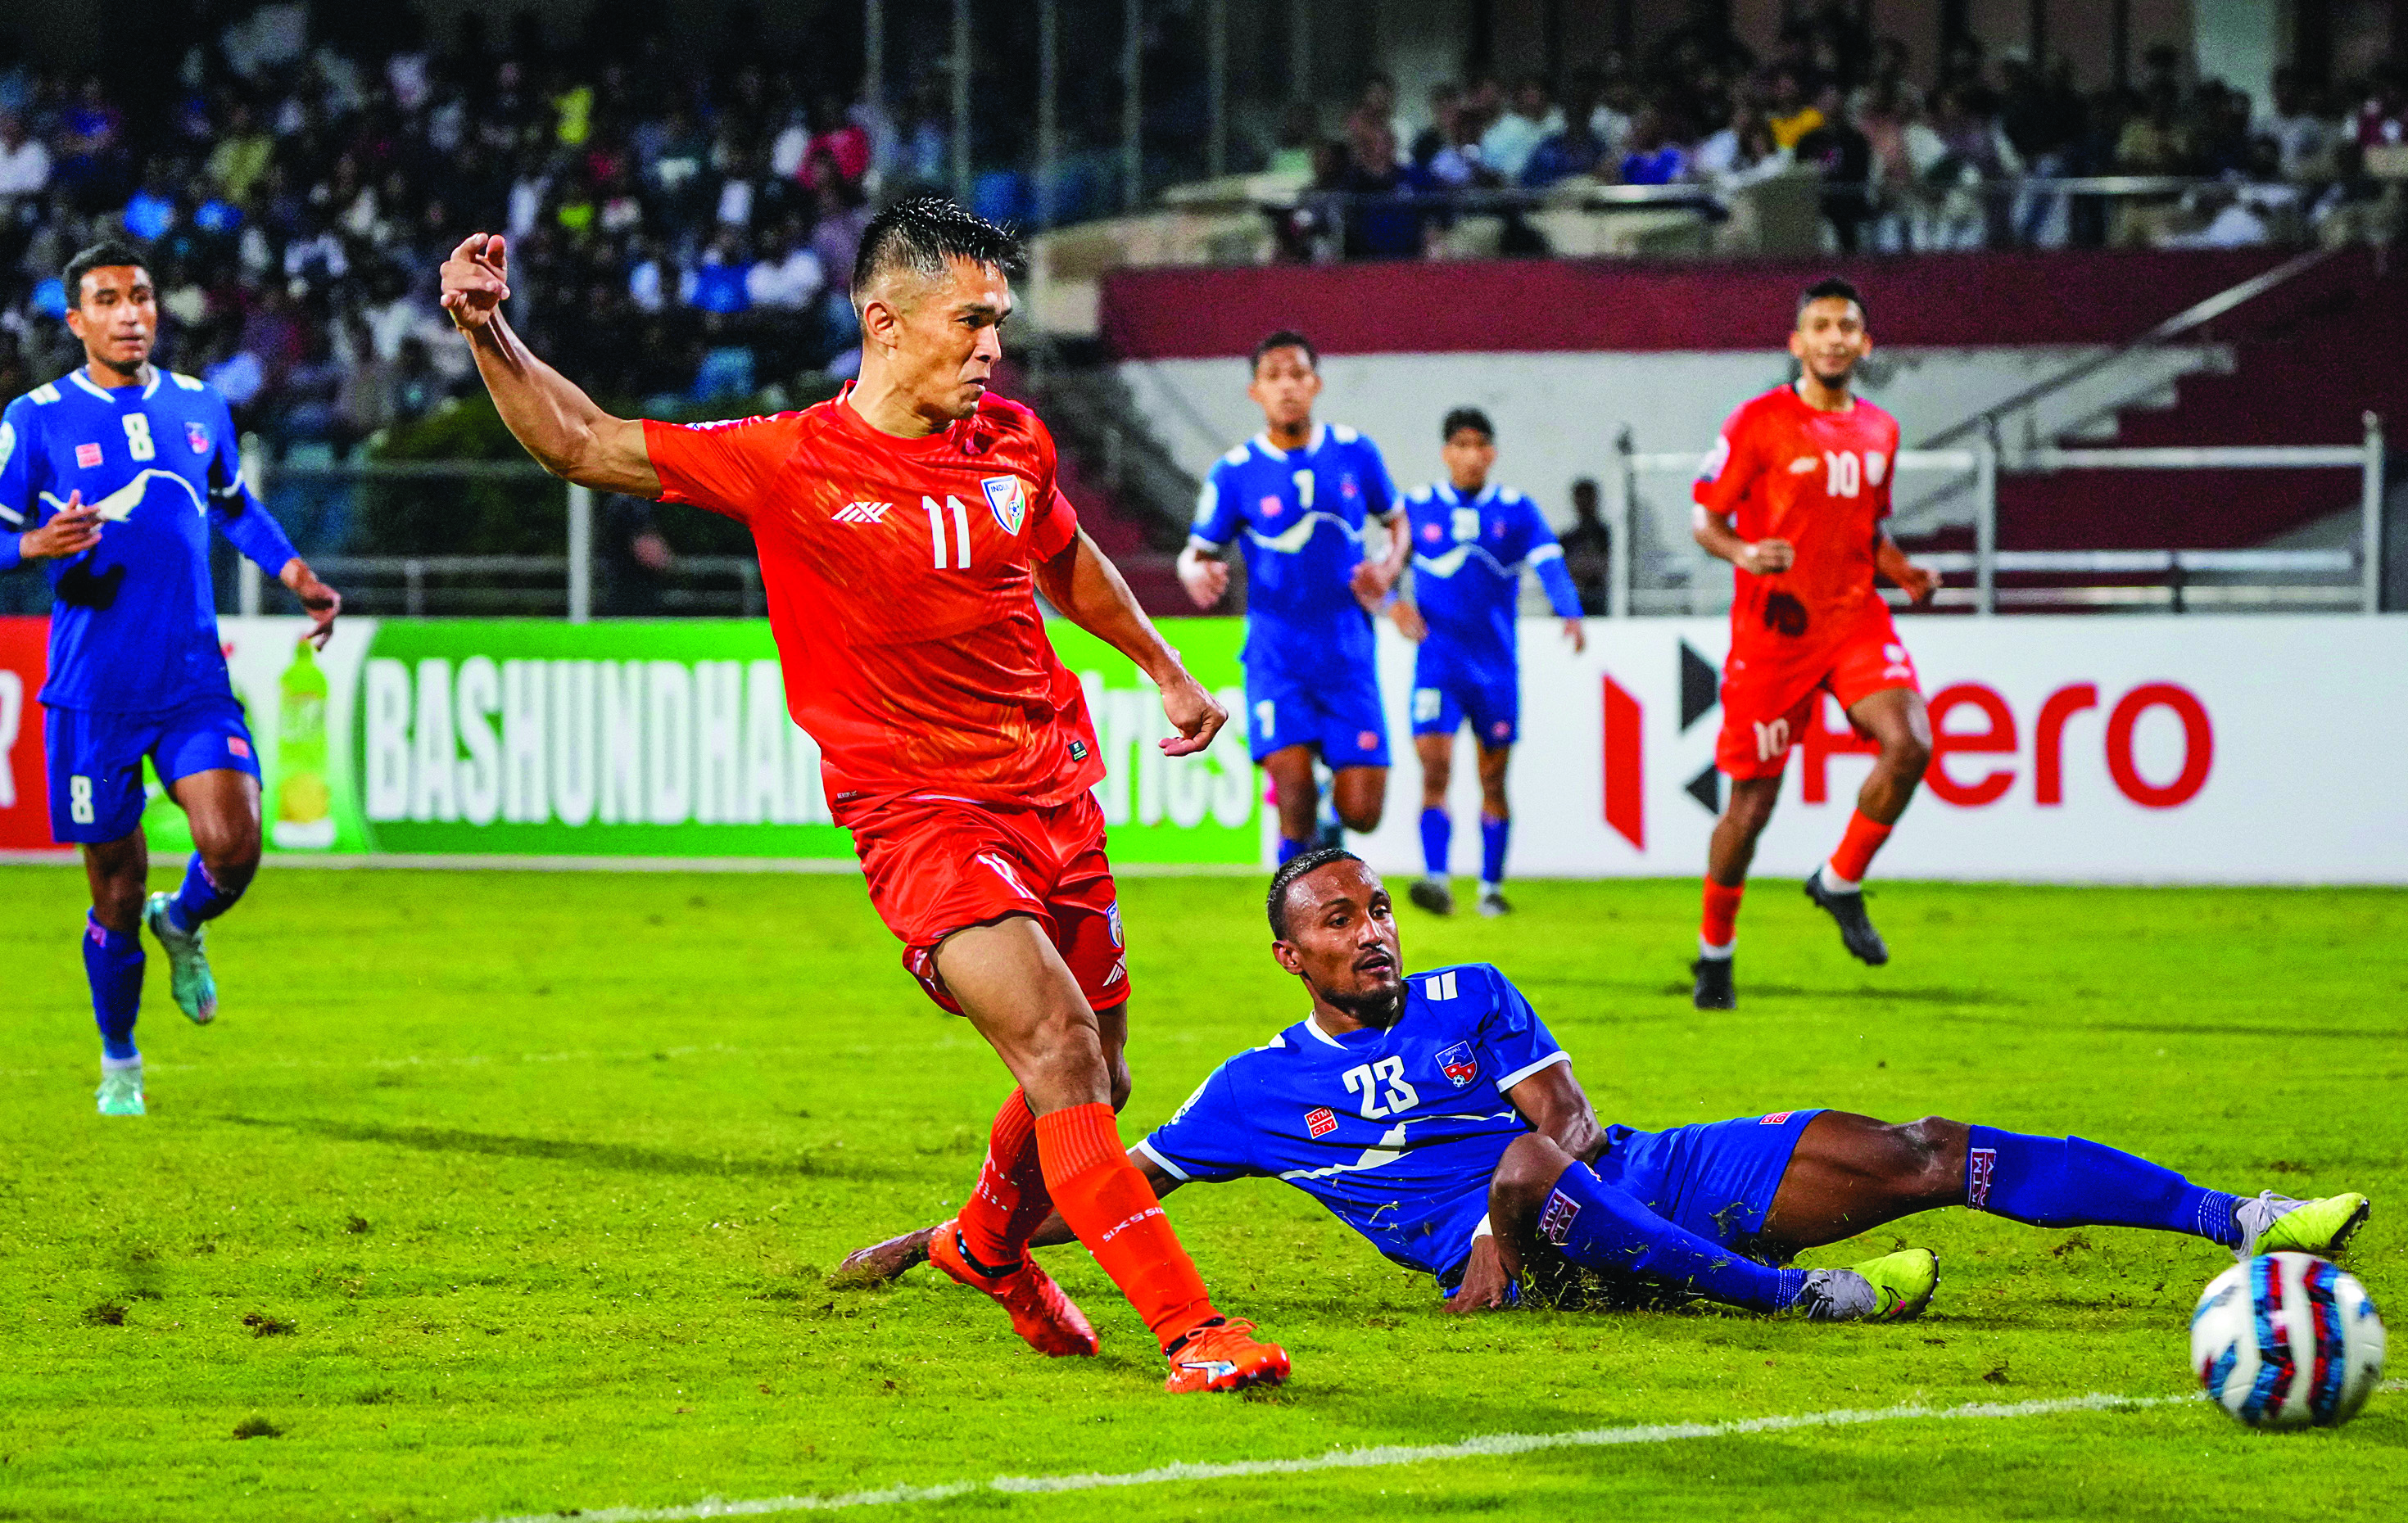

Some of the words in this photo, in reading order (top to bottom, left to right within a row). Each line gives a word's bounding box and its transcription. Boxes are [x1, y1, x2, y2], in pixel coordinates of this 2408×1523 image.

[122, 412, 156, 461] 8
[1824, 450, 1860, 499] 10
[922, 495, 971, 569] 11
[1753, 717, 1790, 762] 10
[1802, 681, 2215, 809] Hero
[70, 775, 95, 824] 8
[1342, 1055, 1419, 1119] 23
[1308, 1109, 1329, 1123] KTM
[1314, 1121, 1333, 1135] CTY
